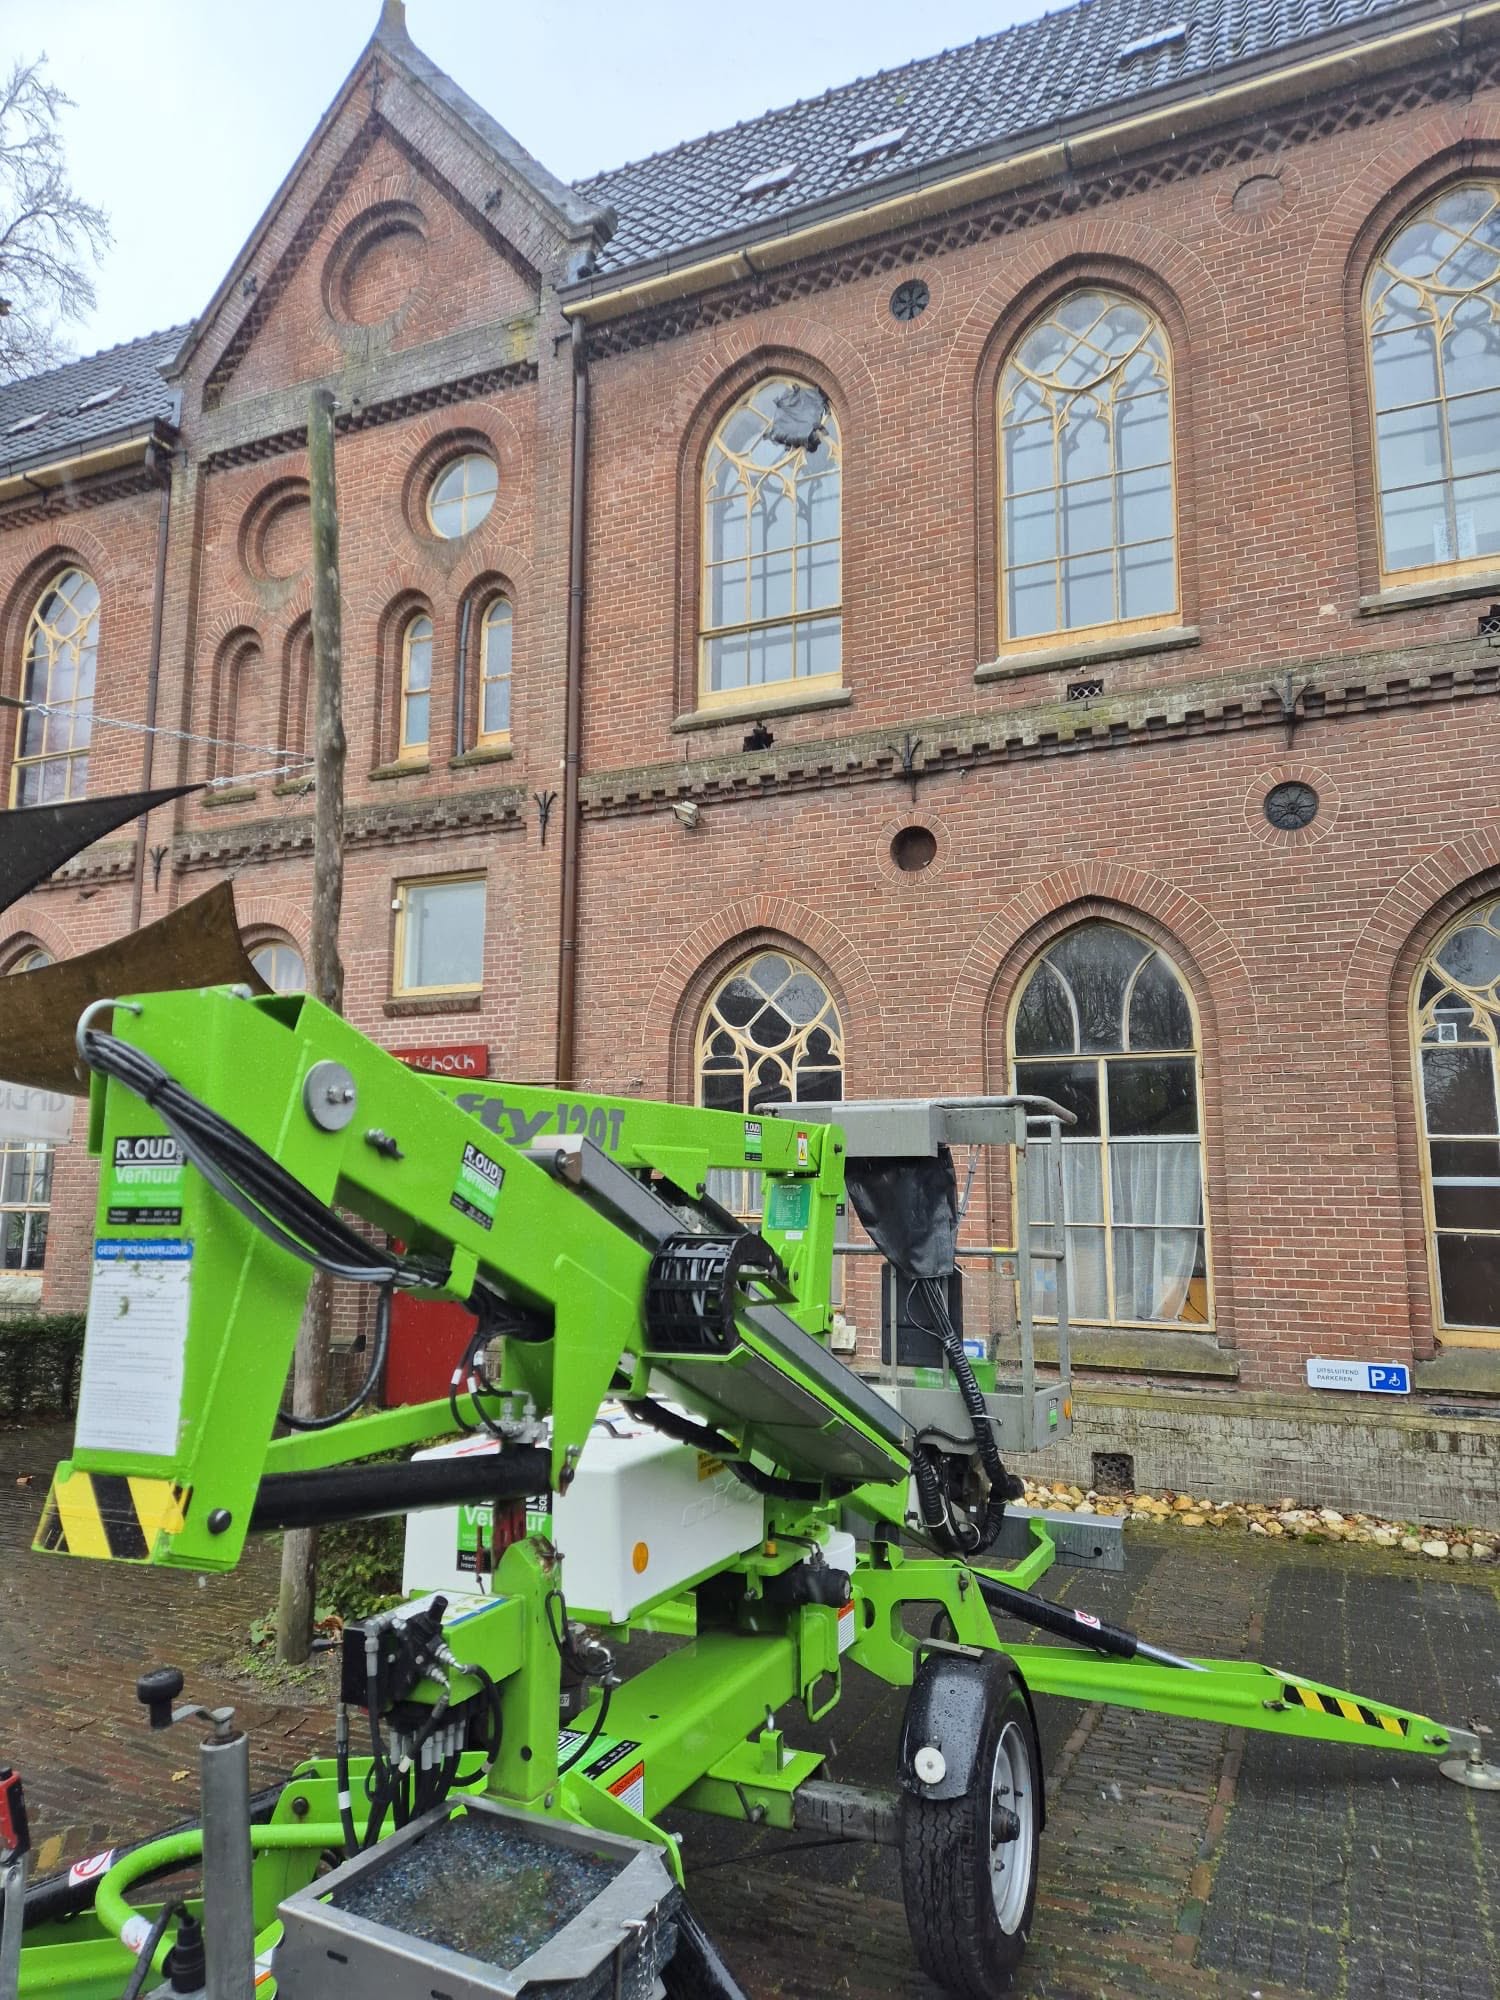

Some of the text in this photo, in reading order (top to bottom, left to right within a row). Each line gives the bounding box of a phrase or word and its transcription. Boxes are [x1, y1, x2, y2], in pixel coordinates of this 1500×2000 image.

[453, 1092, 626, 1151] fty 120T
[115, 1138, 177, 1160] R.OUD
[464, 1144, 499, 1180] R.OUD
[115, 1165, 181, 1184] Verhuur
[1316, 1367, 1386, 1387] UITSLUITEND P
[1317, 1374, 1353, 1382] PARKEREN
